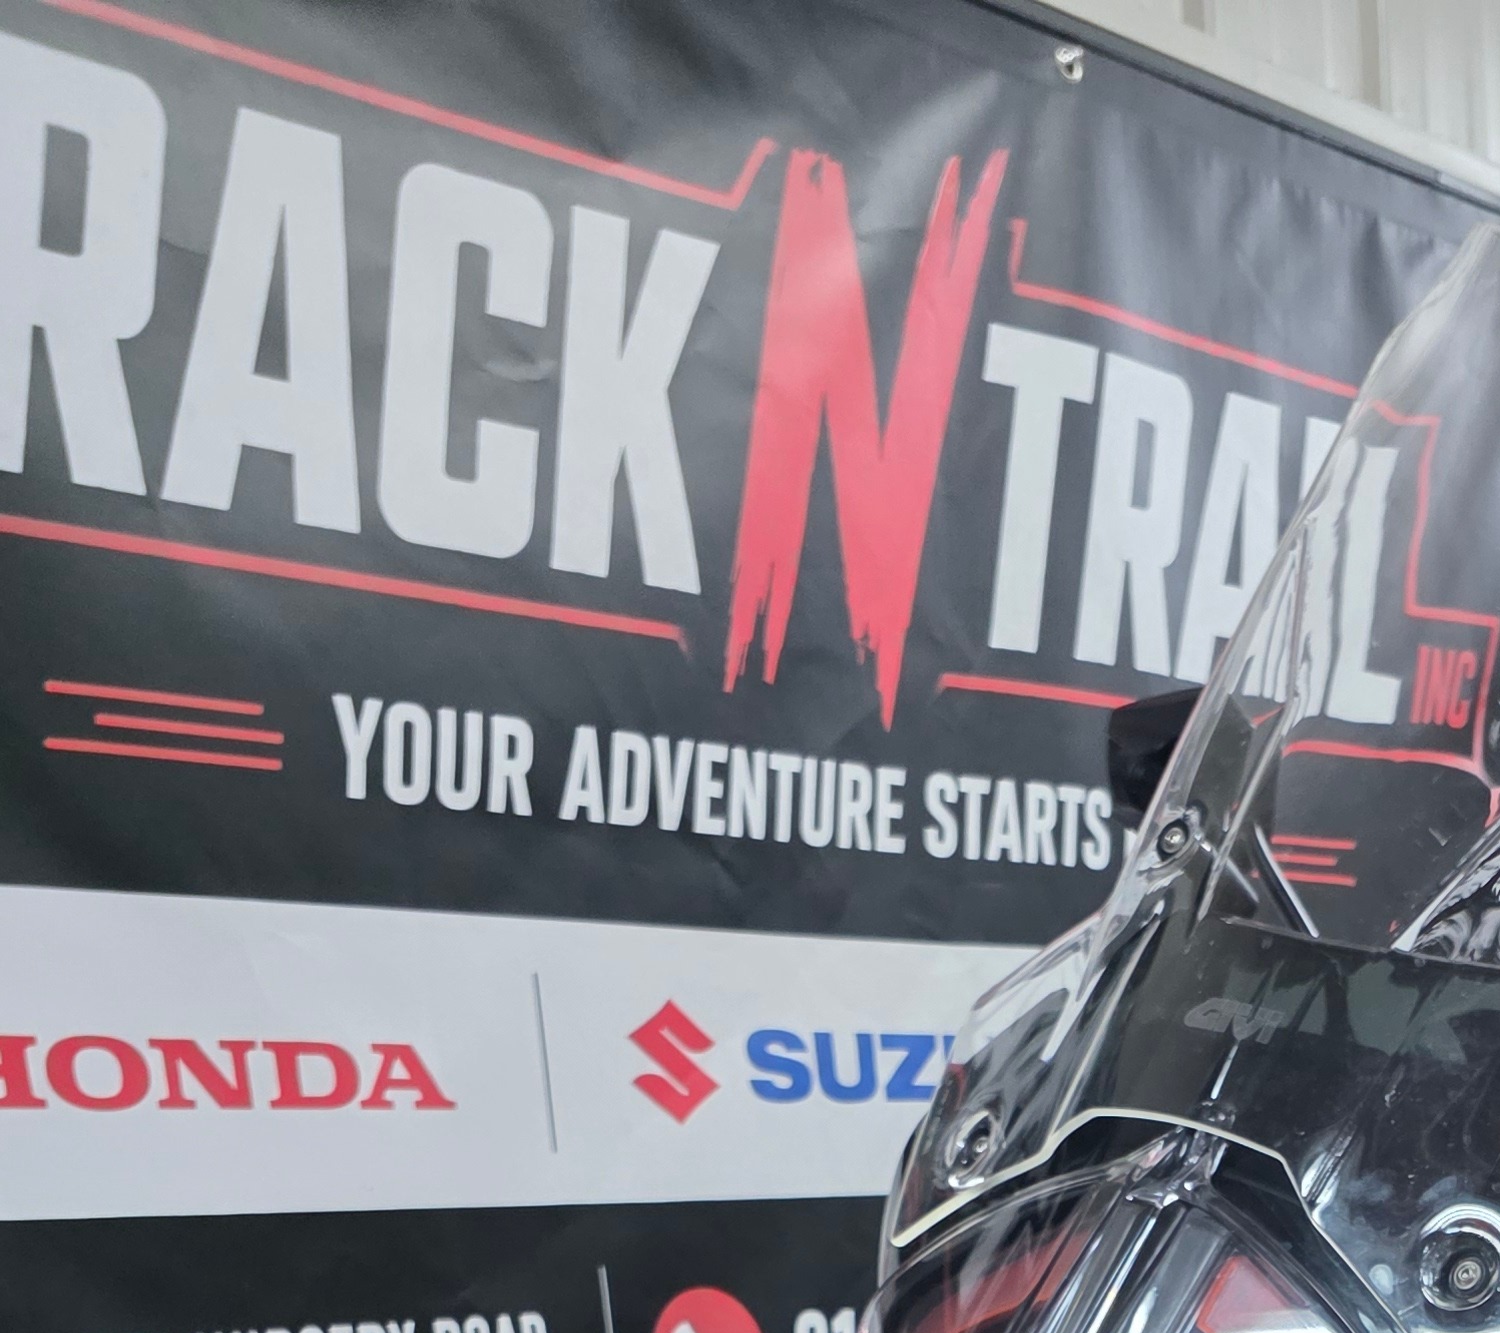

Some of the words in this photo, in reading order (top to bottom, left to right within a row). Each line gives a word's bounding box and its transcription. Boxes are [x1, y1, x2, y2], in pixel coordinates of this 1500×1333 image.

[0, 30, 721, 596] RACK
[723, 147, 1010, 733] N
[1409, 644, 1477, 729] INC
[332, 693, 534, 819] YOUR
[559, 724, 907, 859] ADVENTURE
[922, 770, 1113, 871] STARTS
[746, 1028, 956, 1105] SUZ
